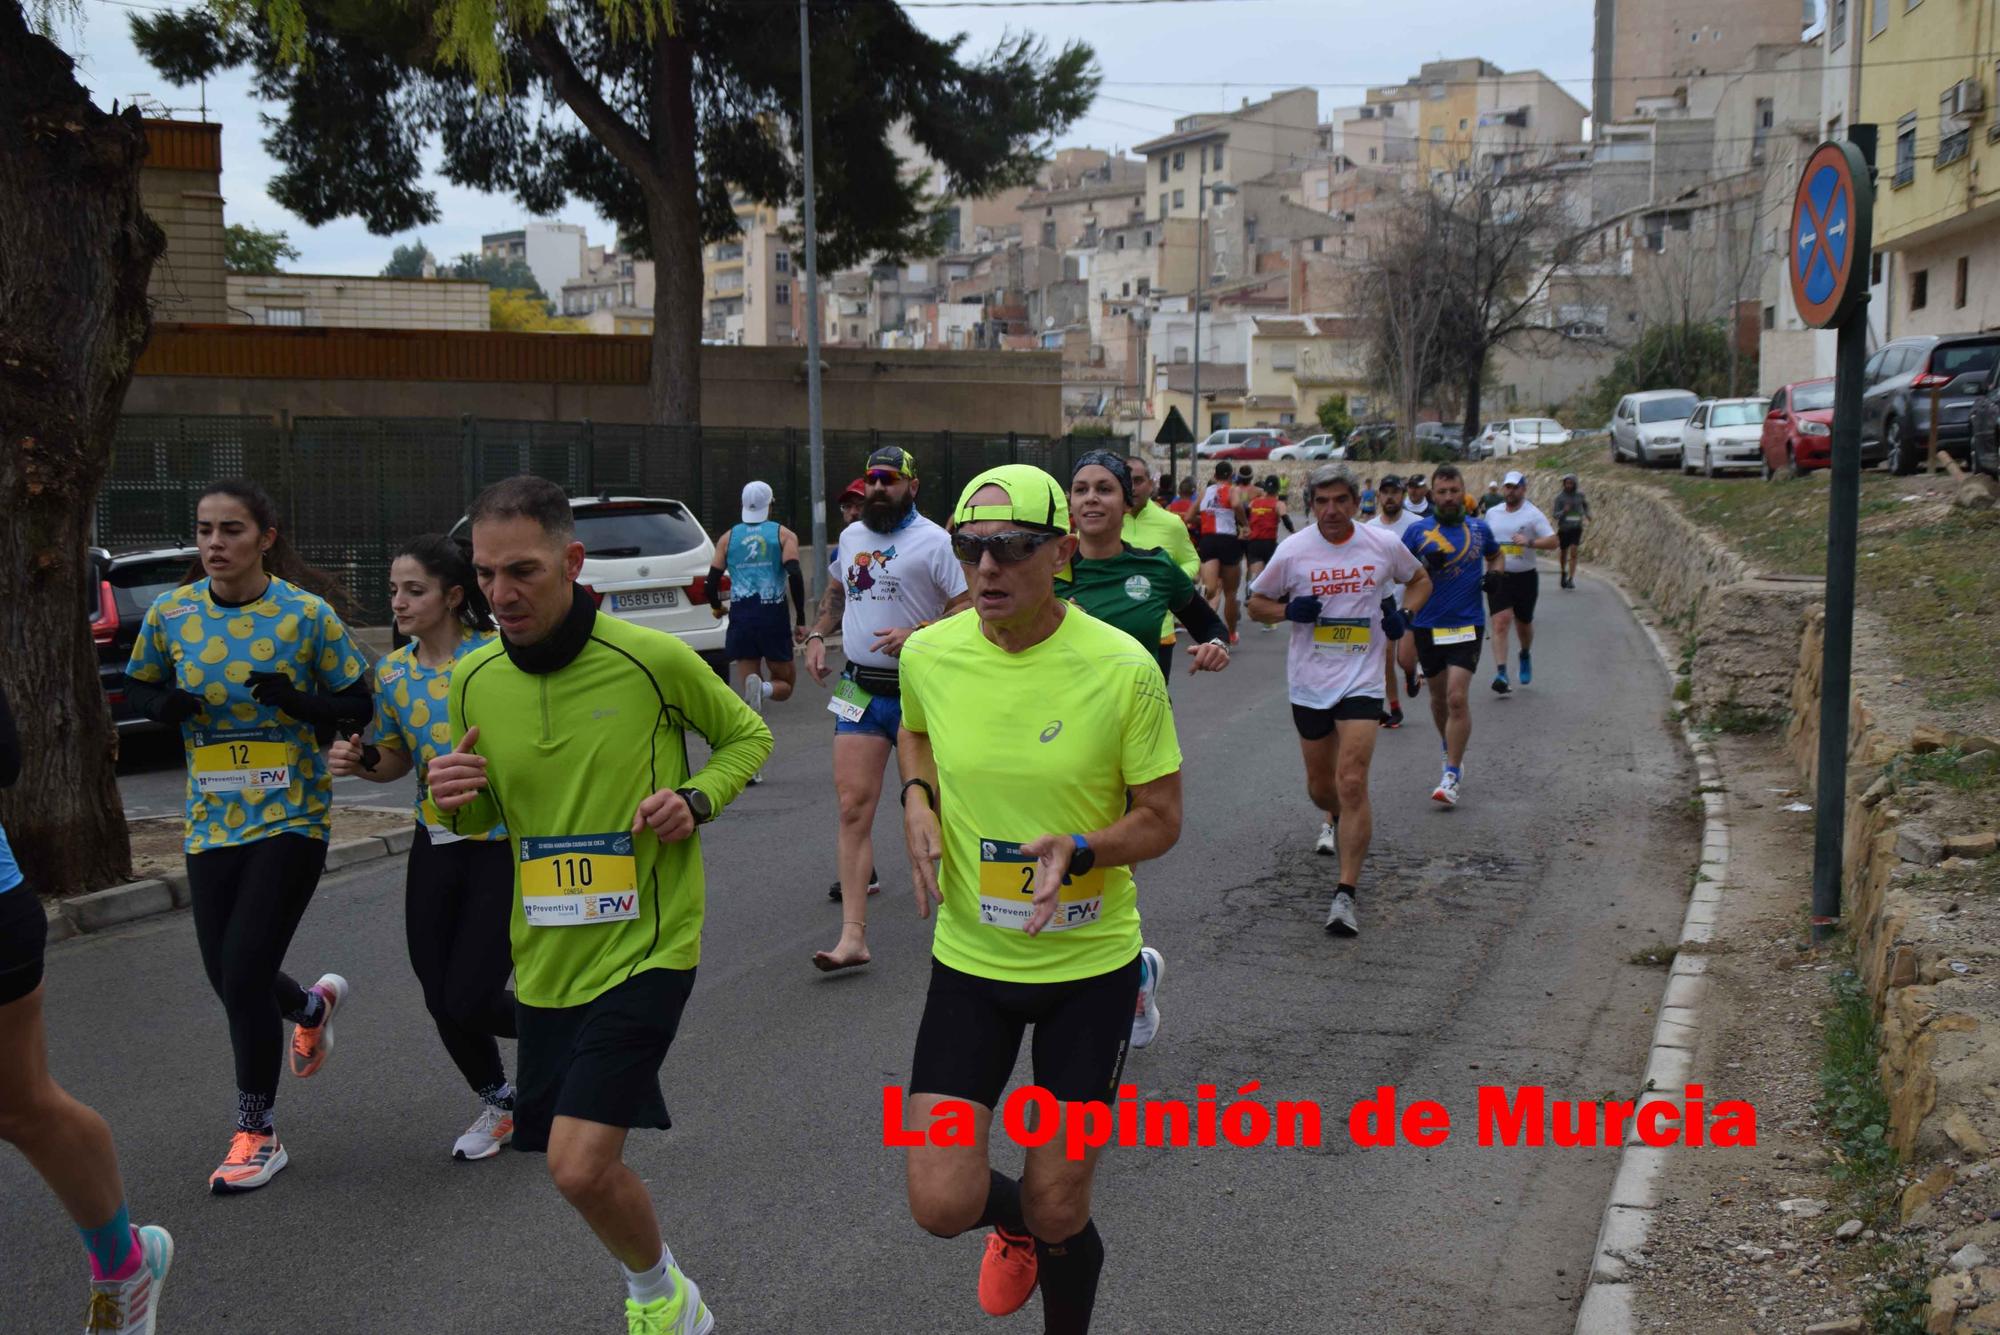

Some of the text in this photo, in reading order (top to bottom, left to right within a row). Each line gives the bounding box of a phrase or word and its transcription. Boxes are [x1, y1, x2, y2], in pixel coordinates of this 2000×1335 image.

[1311, 568, 1361, 582] LA ELA
[1312, 582, 1361, 597] EXISTE
[619, 592, 675, 607] 0589 GYB
[1332, 627, 1353, 640] 207
[228, 744, 250, 765] 12
[552, 858, 593, 887] 110
[532, 902, 575, 913] Preventiva
